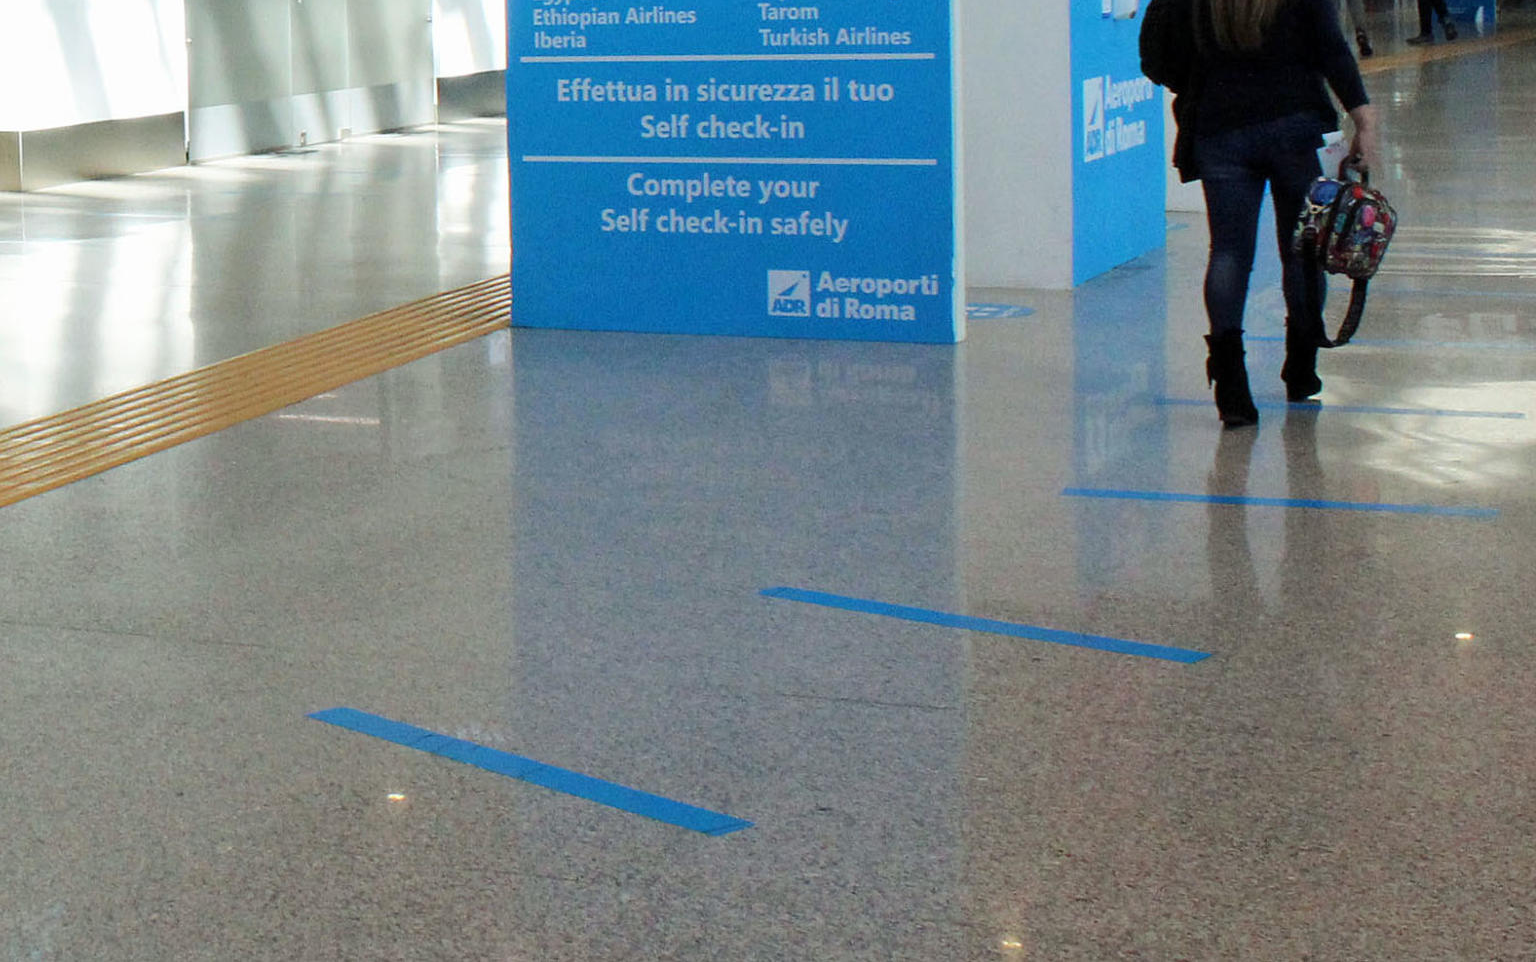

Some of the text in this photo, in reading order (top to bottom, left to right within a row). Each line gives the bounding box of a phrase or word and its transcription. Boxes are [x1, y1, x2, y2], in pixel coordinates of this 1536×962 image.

[533, 7, 696, 28] Ethiopian Airlines
[758, 3, 819, 20] Tarom
[534, 31, 587, 49] Iberia
[759, 27, 911, 47] Turkish Airlines
[557, 78, 894, 102] Effettua in sicurezza il tuo
[641, 114, 805, 139] Self check-in
[627, 173, 820, 204] Complete your
[601, 208, 848, 242] Self check-in safely
[816, 271, 939, 298] Aeroporti
[773, 298, 807, 313] ADR
[816, 298, 916, 321] di Roma
